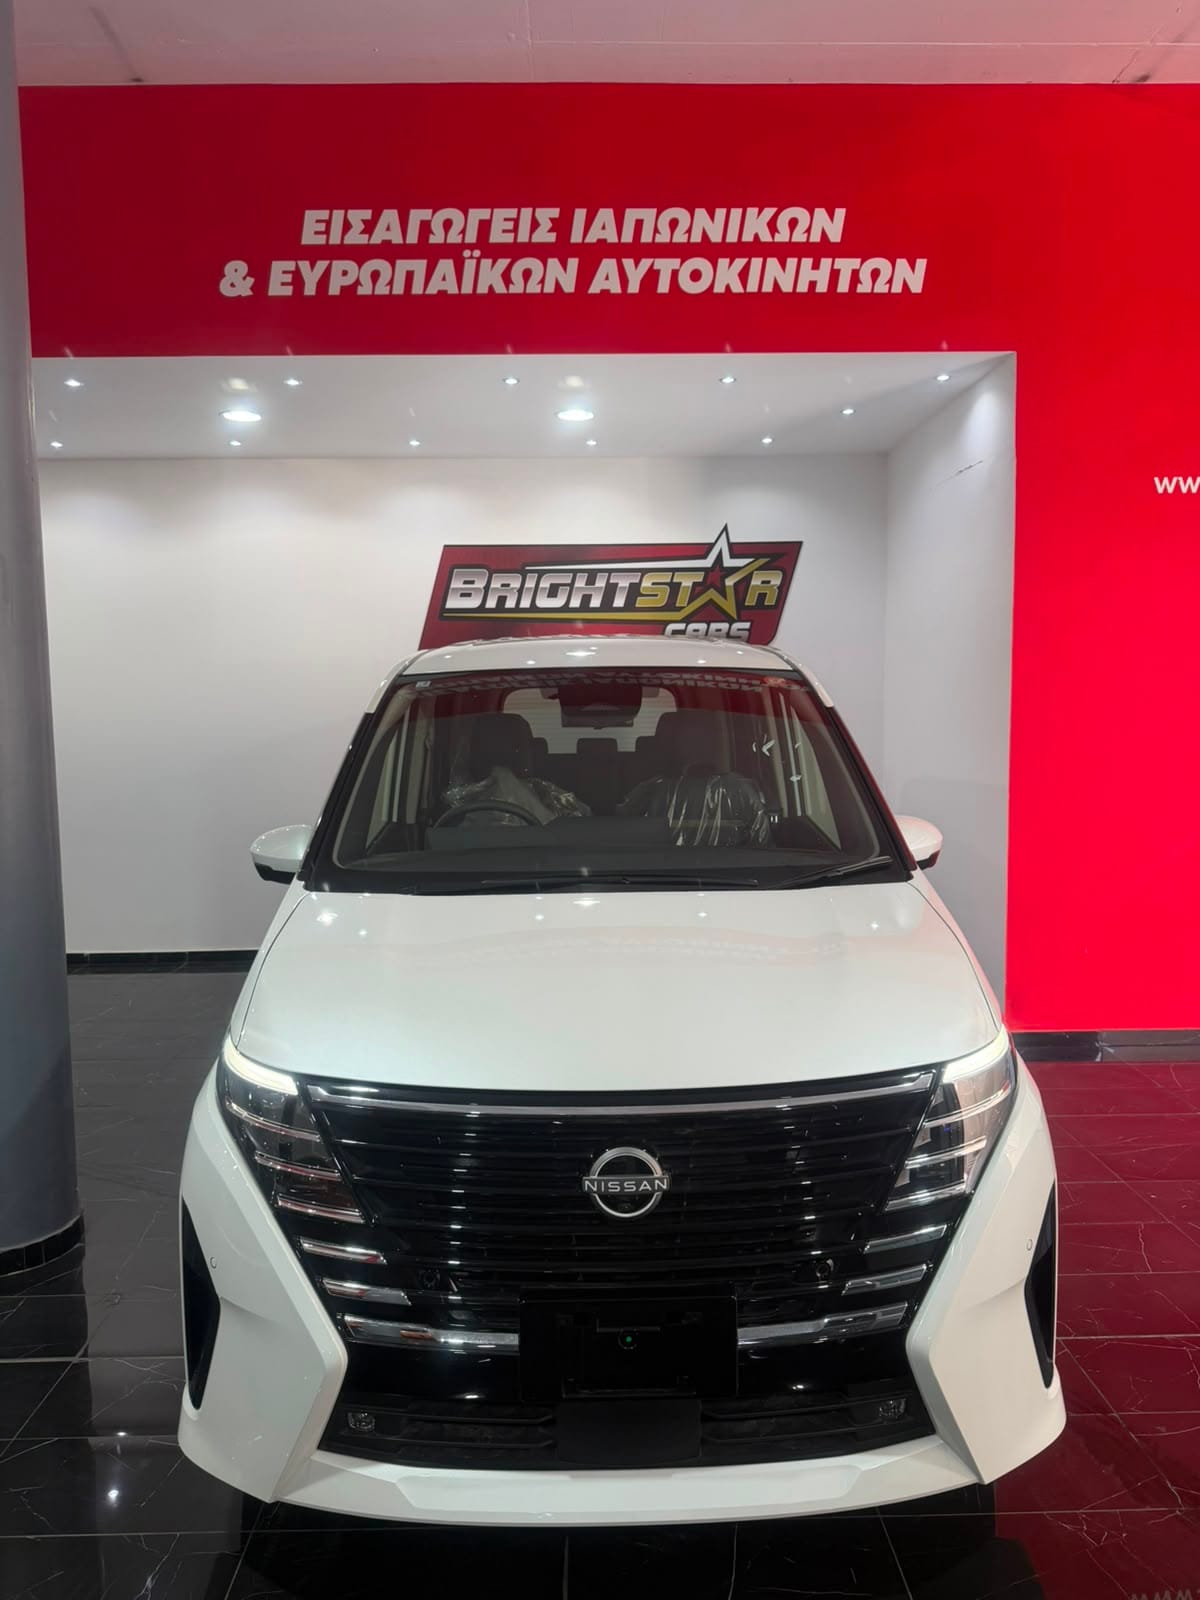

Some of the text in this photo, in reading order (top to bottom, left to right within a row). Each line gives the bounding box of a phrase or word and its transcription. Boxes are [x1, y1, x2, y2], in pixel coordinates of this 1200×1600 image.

[301, 206, 847, 245] ΕΙΣΑΓΩΓΕΙΣ ΙΑΠΩΝΙΚΩΝ
[218, 248, 928, 297] & ΕΥΡΩΠΑΪΚΩΝ ΑΥΤΟΚΙΝΗΤΩΝ
[584, 1178, 668, 1193] NISSAN
